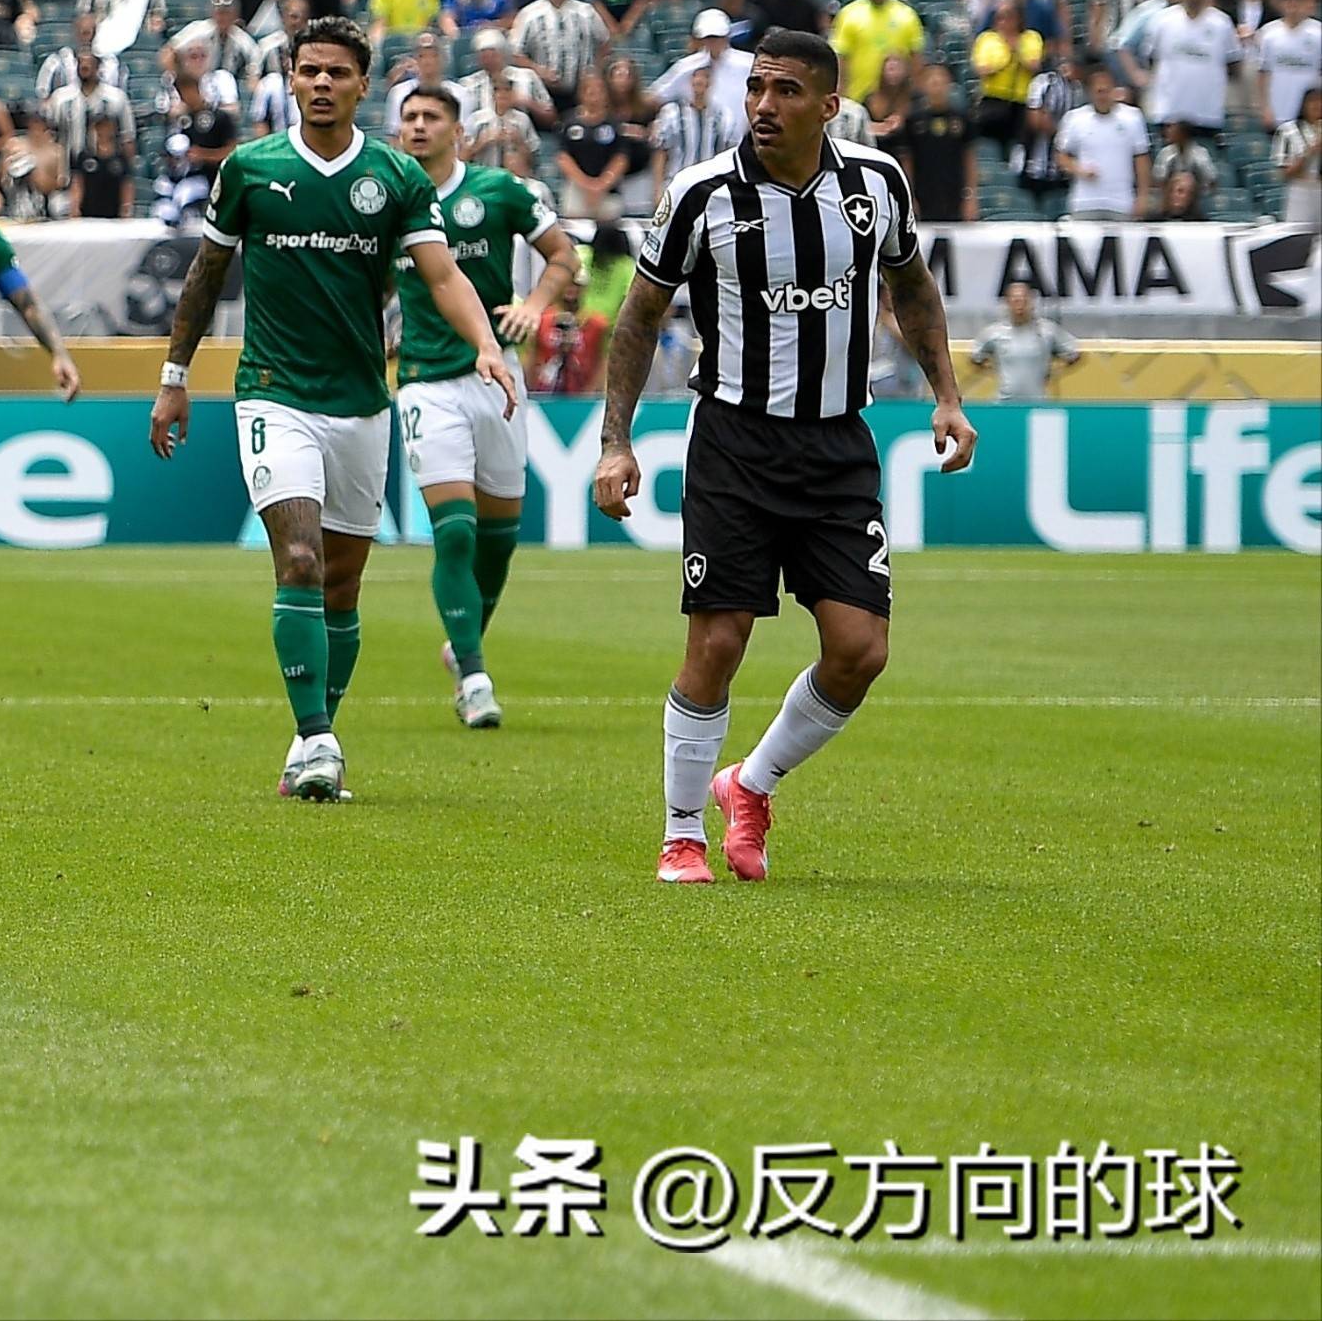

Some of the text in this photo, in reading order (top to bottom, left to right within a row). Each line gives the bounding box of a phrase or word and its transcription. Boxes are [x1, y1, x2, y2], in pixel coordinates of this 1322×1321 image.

[265, 231, 379, 255] sportingbet
[998, 236, 1192, 298] AMA
[759, 279, 850, 313] vbet
[251, 417, 267, 455] 8
